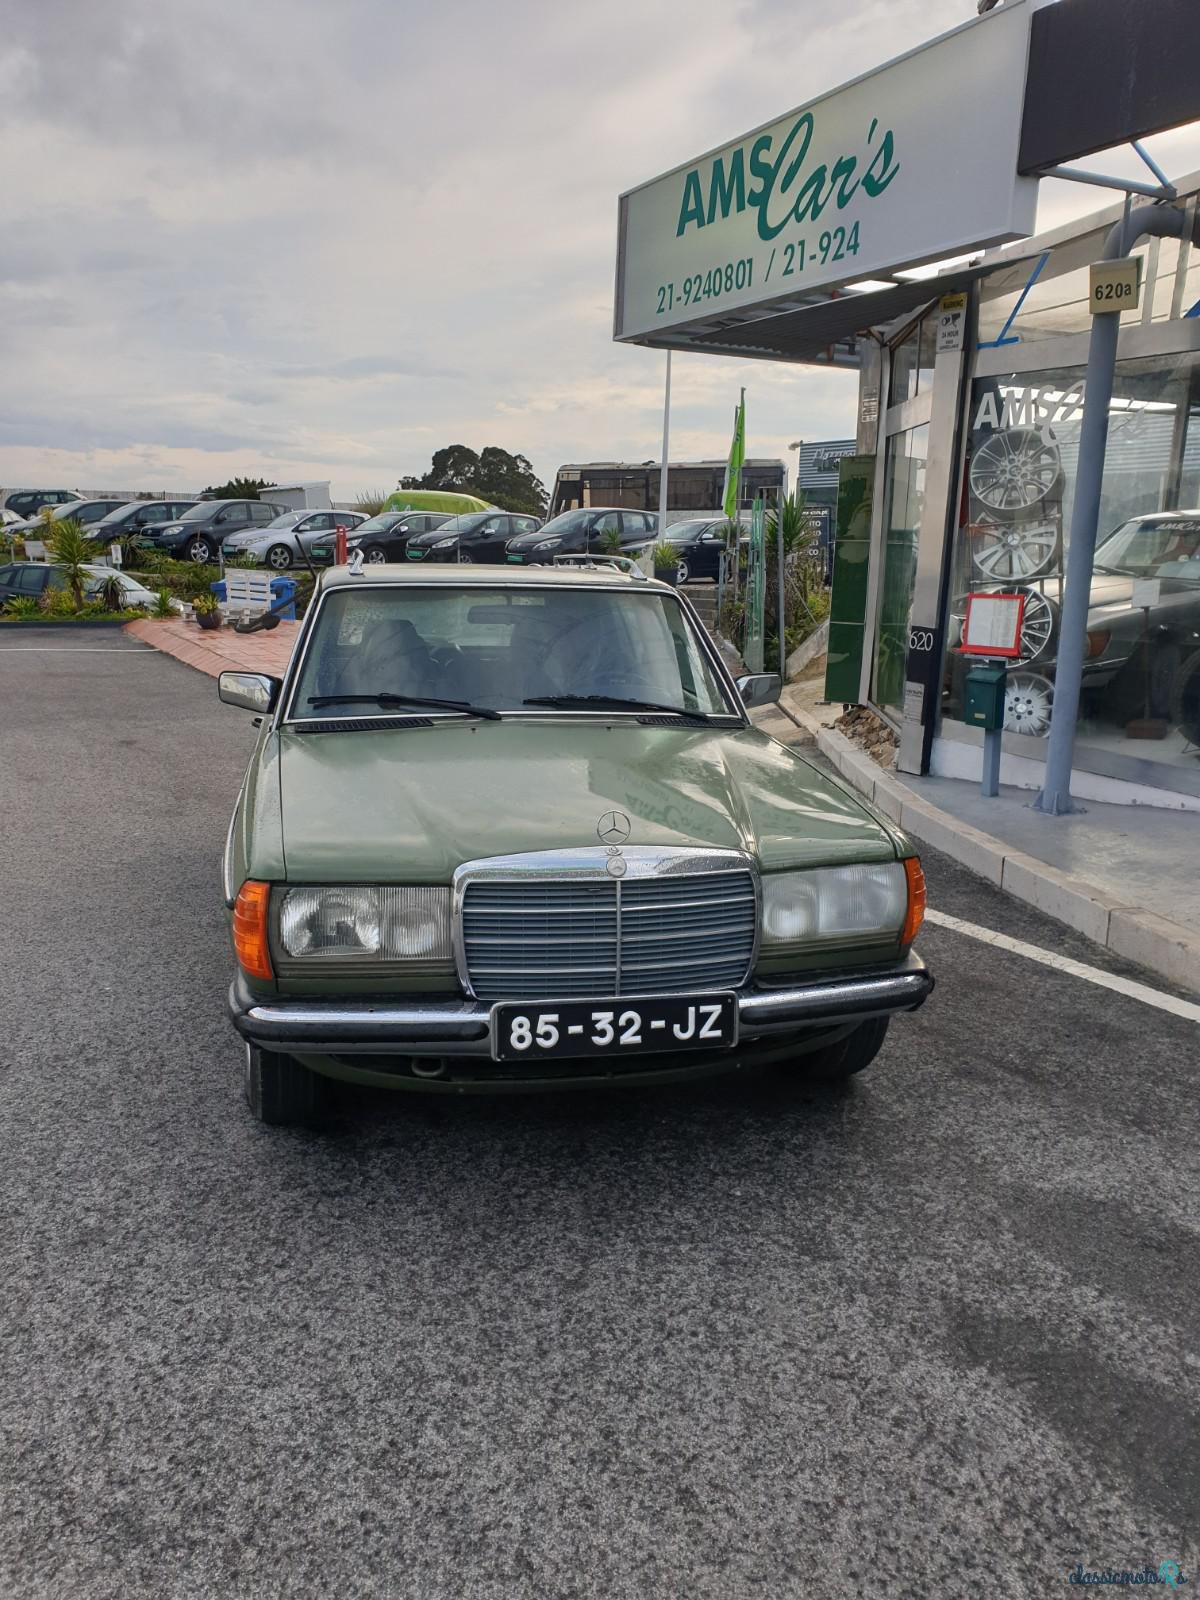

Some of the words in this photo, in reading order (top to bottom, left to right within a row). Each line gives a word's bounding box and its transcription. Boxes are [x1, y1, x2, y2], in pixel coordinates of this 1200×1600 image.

[656, 257, 753, 314] 21-9240801
[782, 220, 860, 277] 21-924
[1094, 282, 1132, 301] 620a
[909, 631, 934, 652] 620
